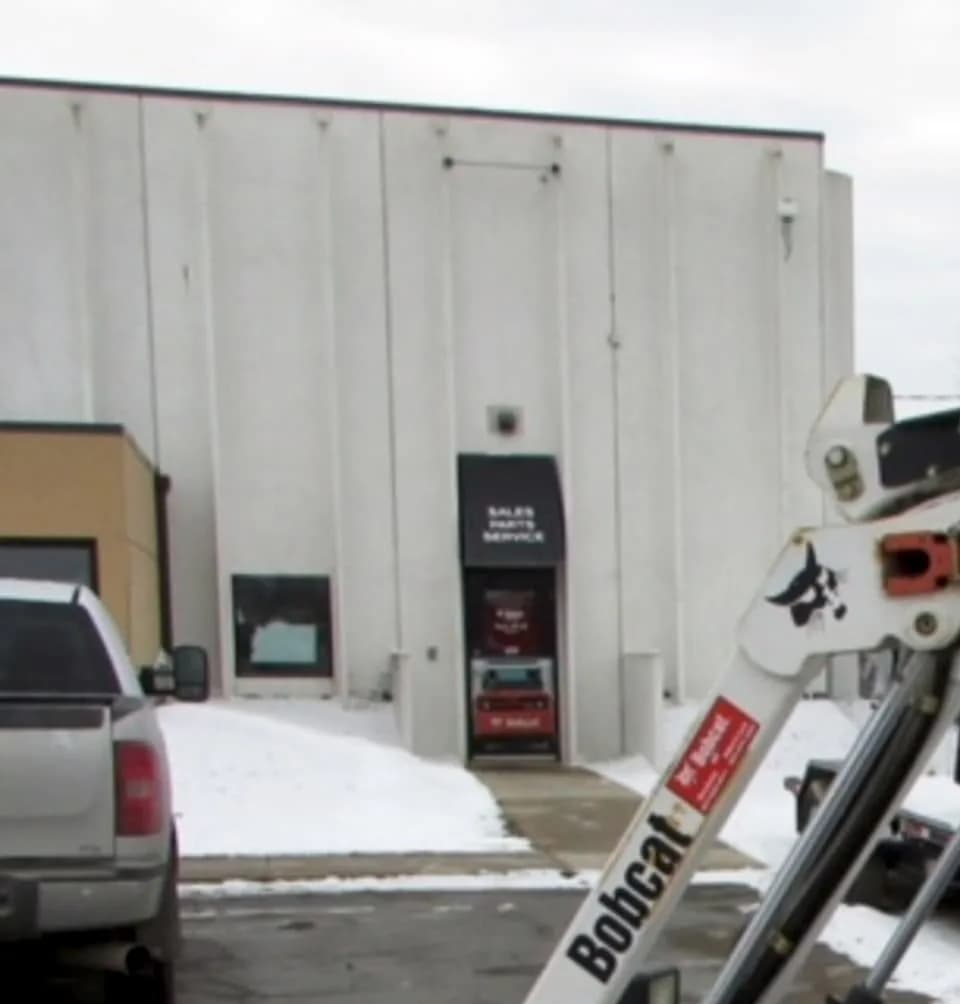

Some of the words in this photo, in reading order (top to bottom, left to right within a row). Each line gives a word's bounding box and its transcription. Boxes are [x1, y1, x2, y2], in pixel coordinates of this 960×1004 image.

[488, 506, 535, 518] SALES
[488, 519, 536, 530] PARTS
[483, 531, 545, 544] SERVICE
[566, 812, 693, 985] Bobcat
